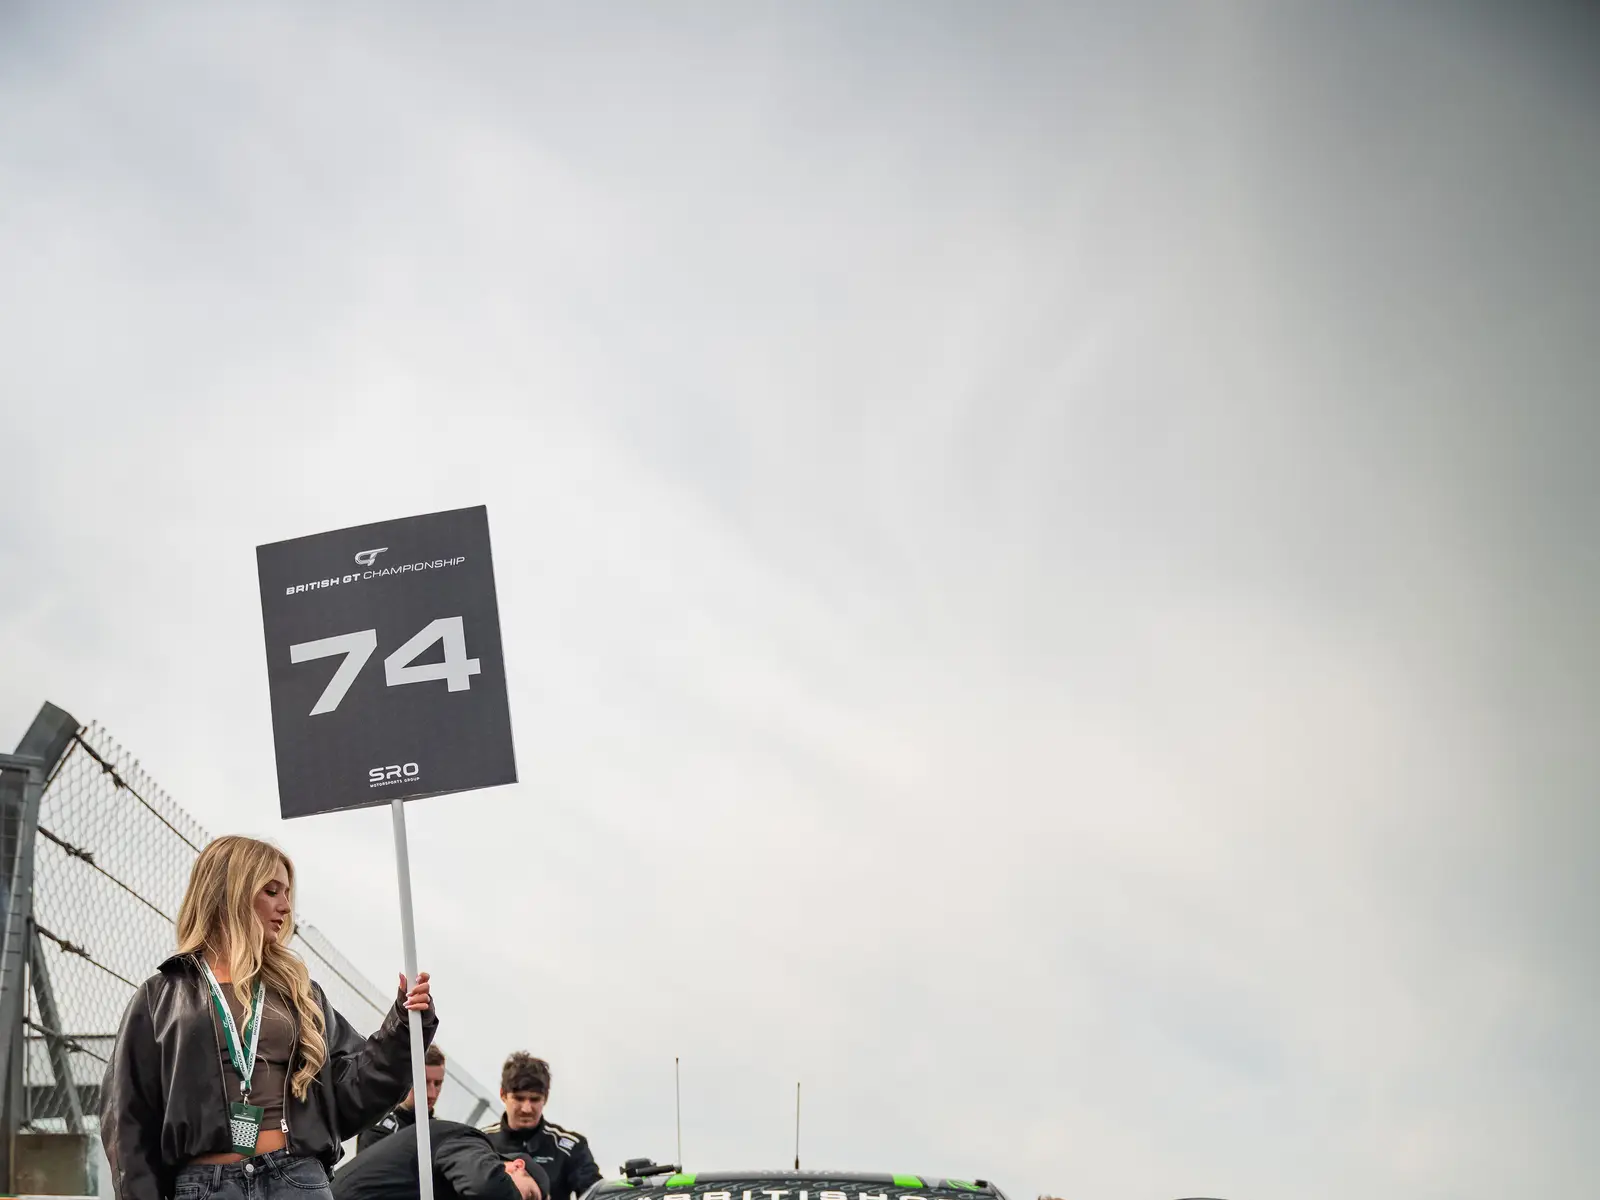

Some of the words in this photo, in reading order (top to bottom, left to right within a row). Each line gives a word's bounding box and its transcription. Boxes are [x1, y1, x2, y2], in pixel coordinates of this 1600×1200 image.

[285, 577, 340, 595] BRITISH
[342, 573, 361, 584] GT
[363, 556, 465, 580] CHAMPIONSHIP
[290, 616, 481, 716] 74
[369, 762, 419, 782] SRO
